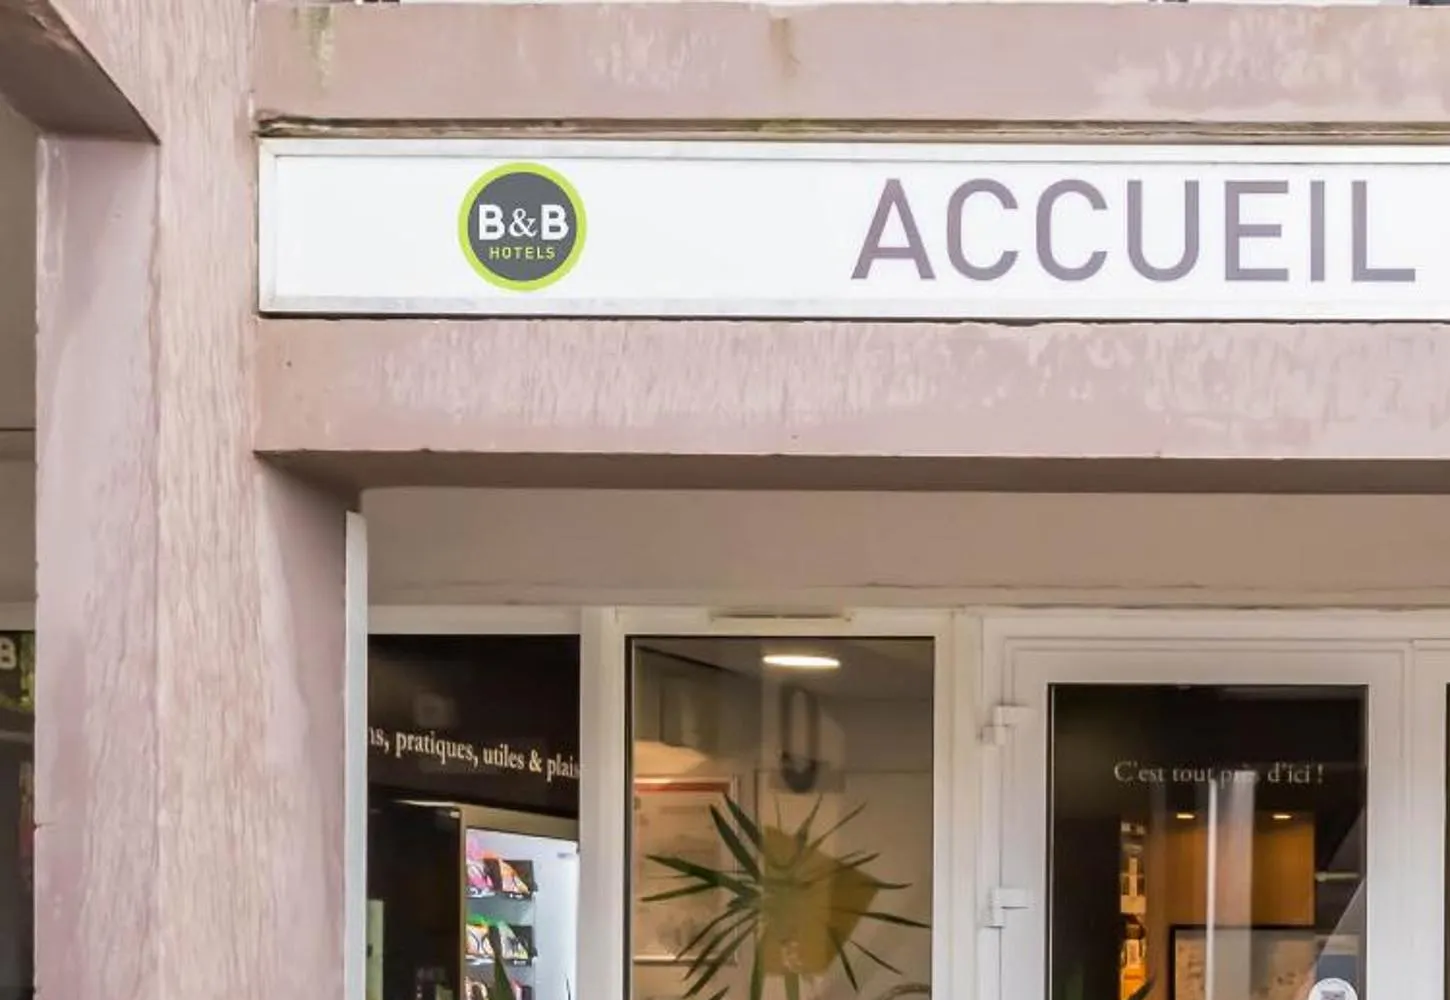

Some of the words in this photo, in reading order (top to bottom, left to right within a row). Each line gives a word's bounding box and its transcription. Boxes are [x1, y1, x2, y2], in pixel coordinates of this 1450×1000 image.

[478, 204, 569, 241] B&B
[850, 177, 1416, 282] ACCUEIL
[488, 247, 556, 259] HOTELS
[395, 730, 479, 767] pratiques,
[482, 743, 525, 769] utiles
[528, 749, 543, 772] &
[1114, 760, 1164, 784] C'est
[1172, 765, 1212, 783] tout
[1267, 761, 1310, 784] d'ici
